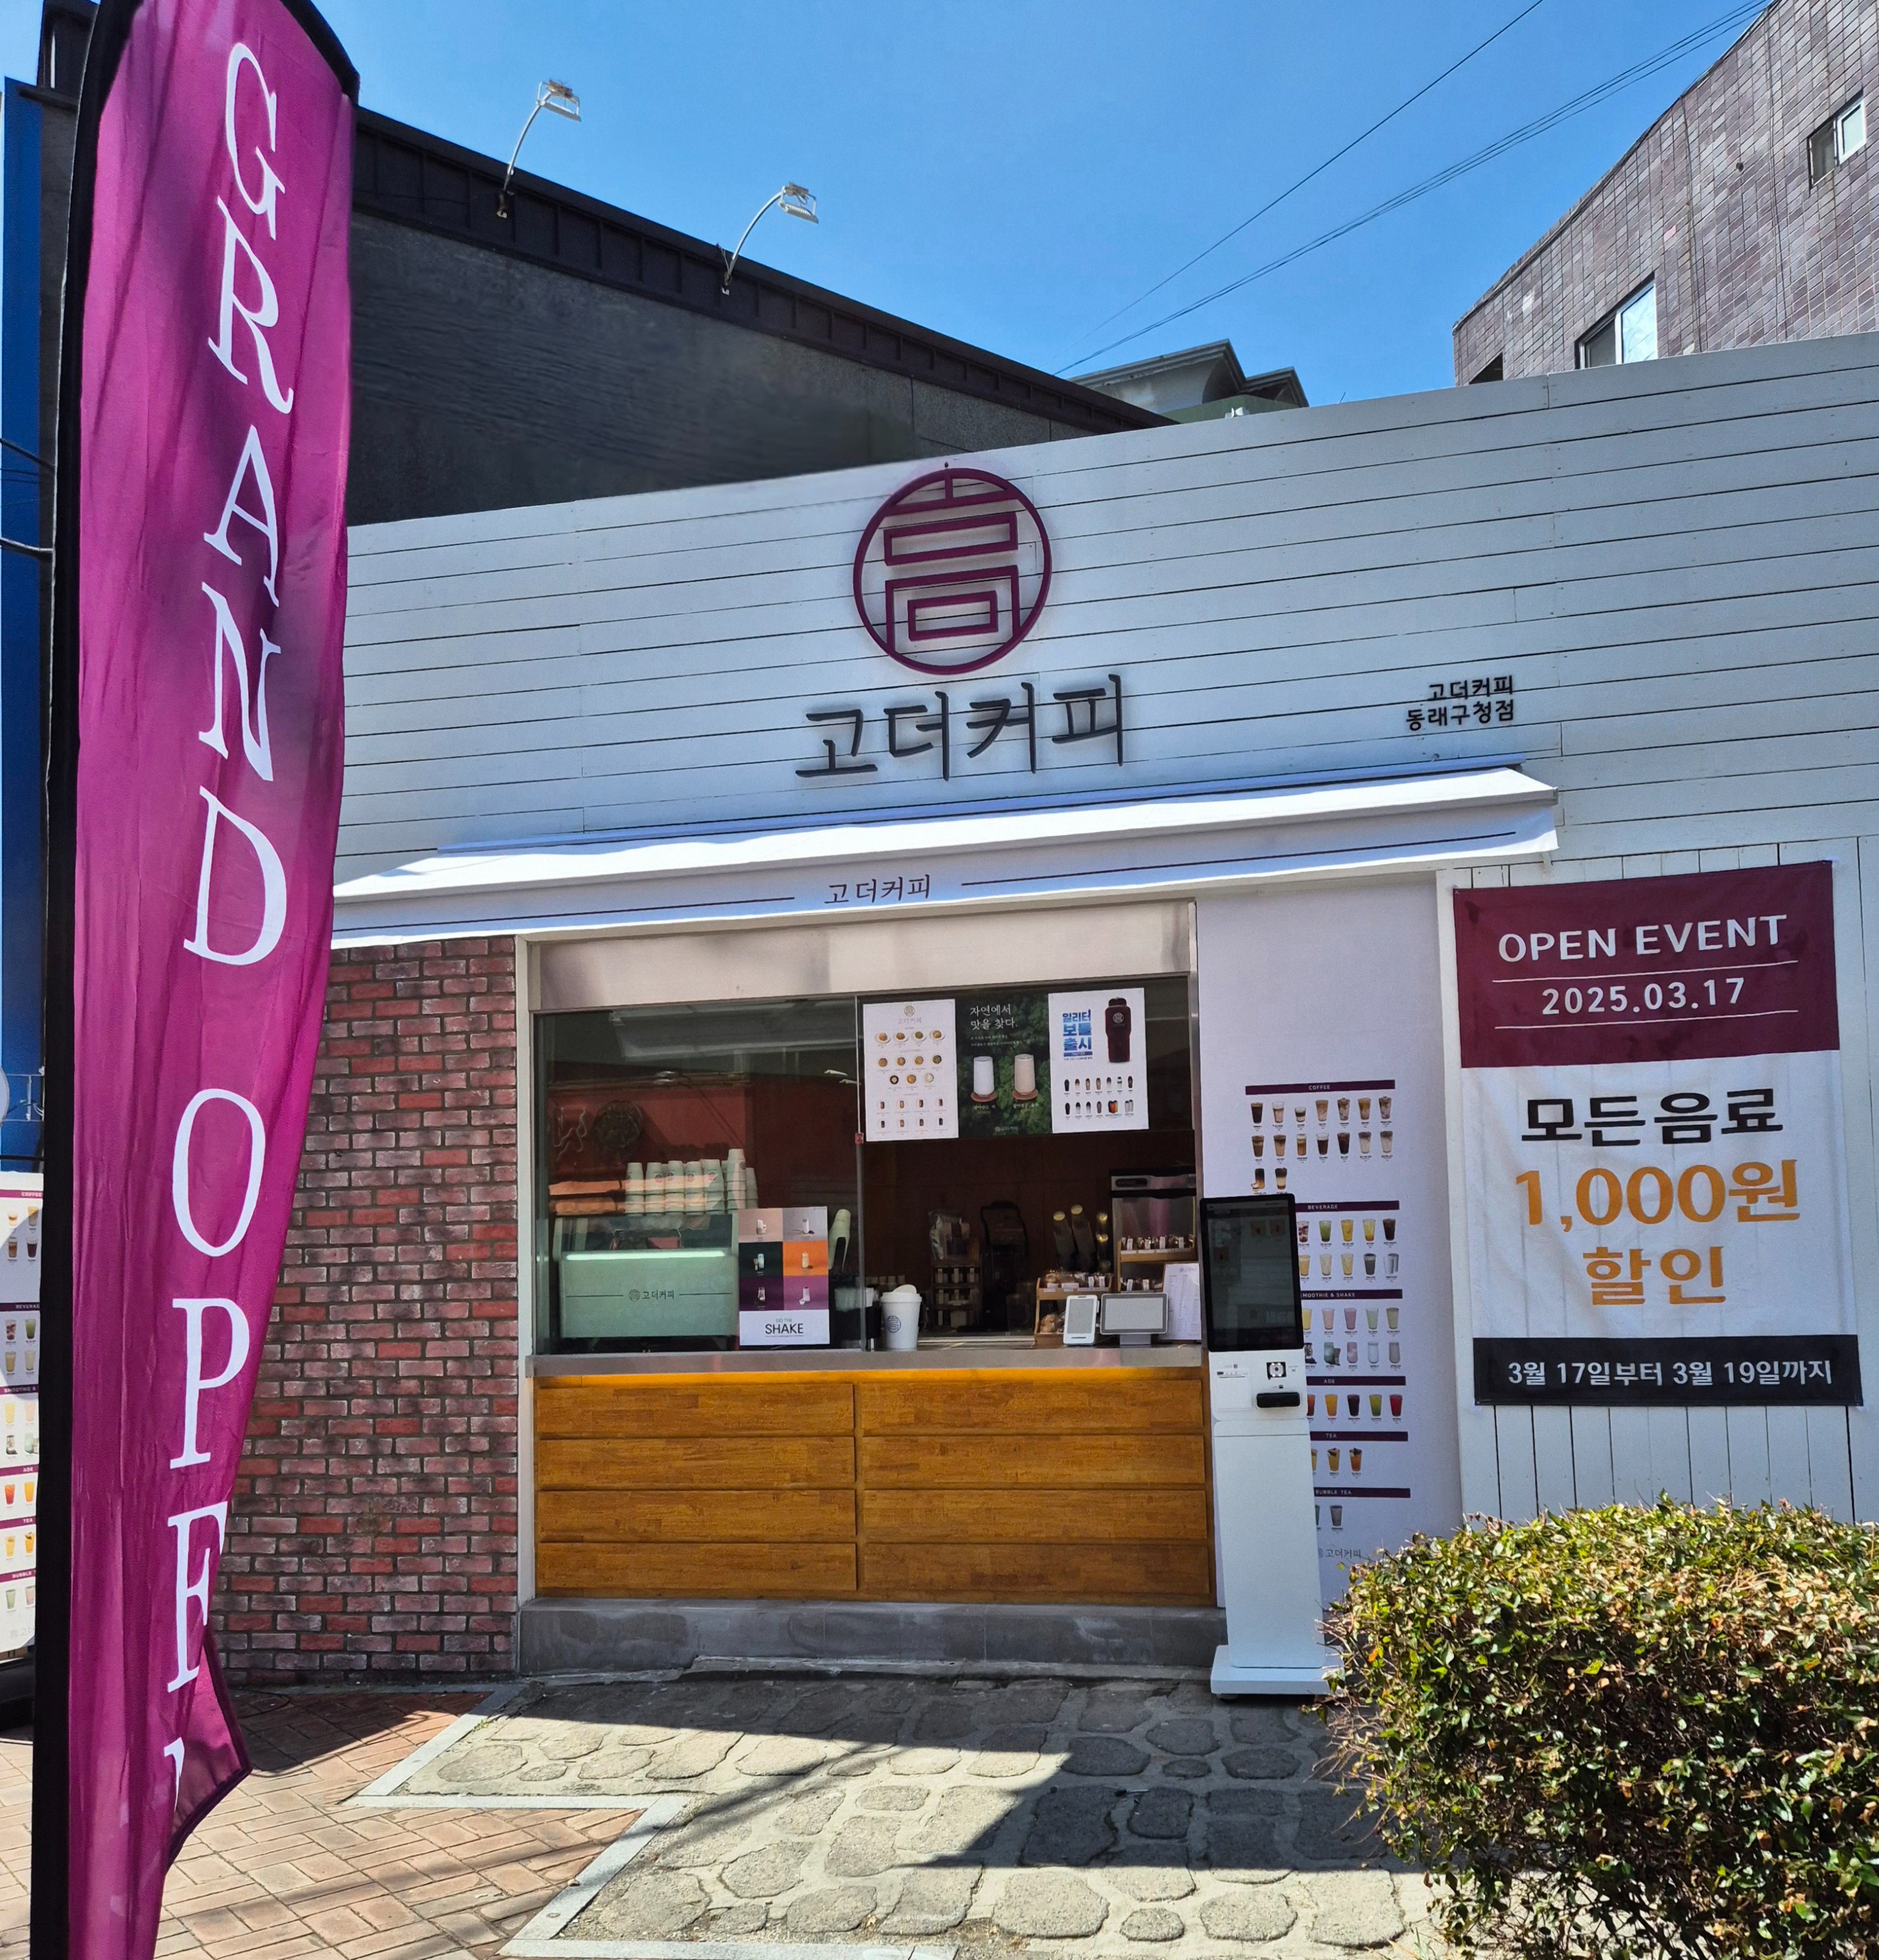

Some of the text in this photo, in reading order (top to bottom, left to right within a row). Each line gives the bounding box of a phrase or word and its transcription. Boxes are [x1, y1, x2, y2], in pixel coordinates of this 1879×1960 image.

[1428, 675, 1513, 701] 고더커피
[796, 674, 1123, 781] 고더커피
[1406, 699, 1514, 731] 동래구청점
[824, 874, 930, 904] 고더커피
[164, 43, 294, 1812] GRAND OPE
[1498, 914, 1787, 962] OPEN EVENT
[1542, 977, 1745, 1015] 2025.03.17
[970, 1004, 1011, 1017] 자연에서
[1062, 1008, 1092, 1023] 일리터
[970, 1019, 991, 1030] 맛을
[1063, 1023, 1092, 1036] 보틀
[1063, 1037, 1092, 1051] 출시
[1521, 1088, 1784, 1147] 모든음료
[1515, 1159, 1800, 1232] 1,000원
[1582, 1246, 1726, 1306] 할인
[642, 1289, 674, 1300] 고더커피
[765, 1323, 803, 1334] SHAKE
[1508, 1360, 1833, 1386] 3월 17일부터 3월 19일까지
[1326, 1549, 1362, 1559] 고더커피
